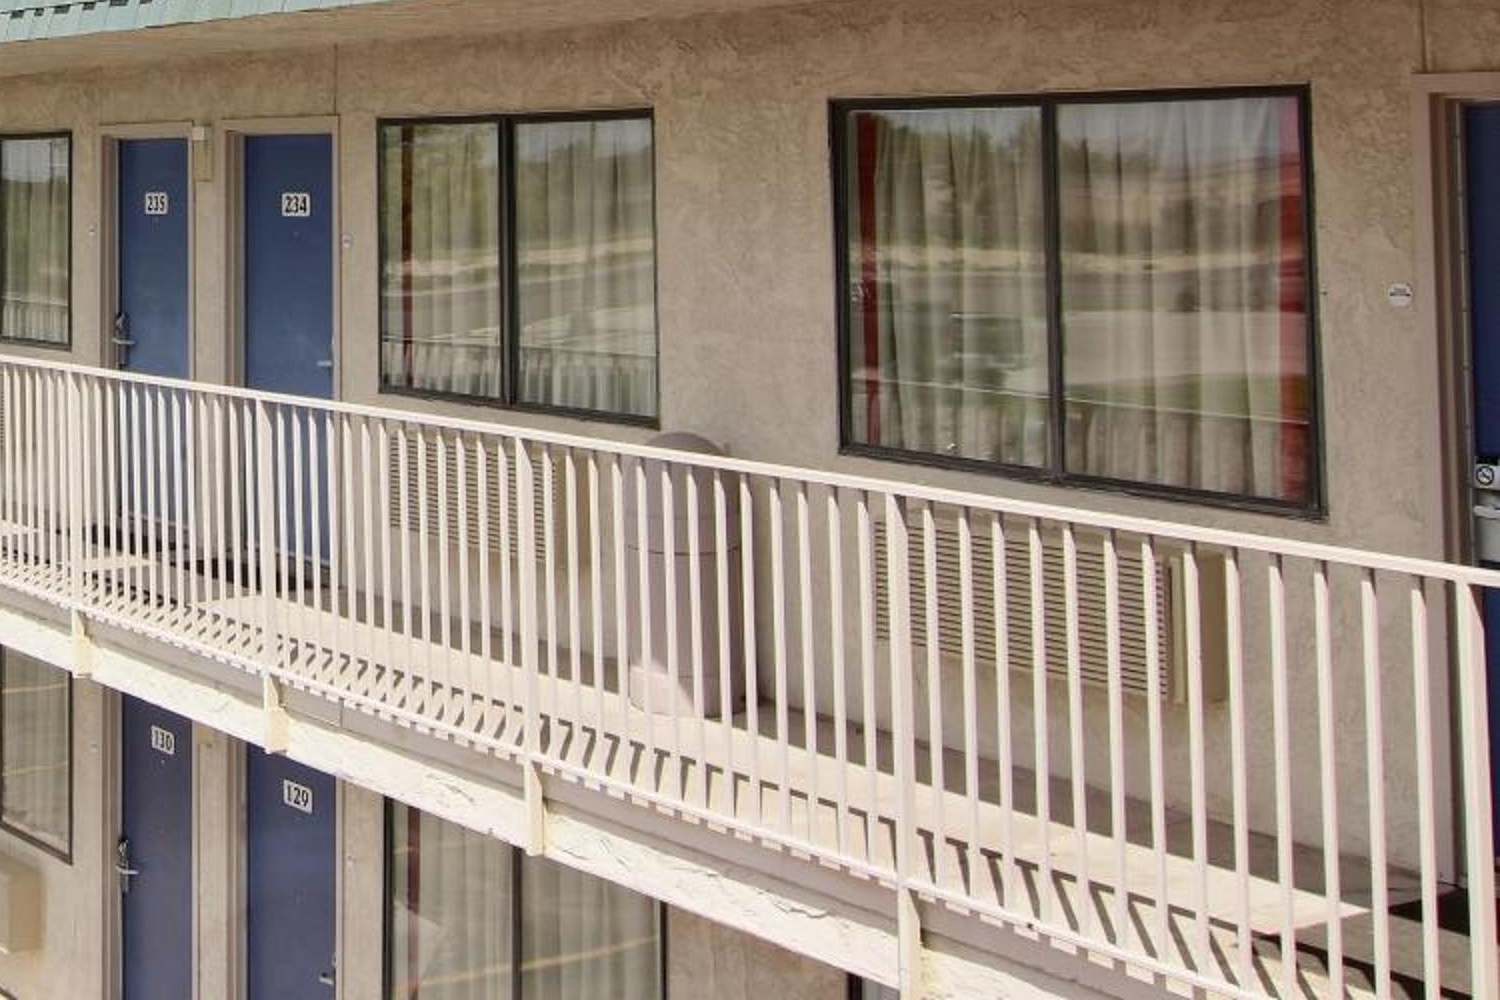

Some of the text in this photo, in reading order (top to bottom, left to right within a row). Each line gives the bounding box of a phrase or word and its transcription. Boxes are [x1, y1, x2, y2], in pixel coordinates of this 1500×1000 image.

[285, 195, 307, 213] 234
[154, 729, 173, 751] 130
[287, 784, 309, 807] 129
